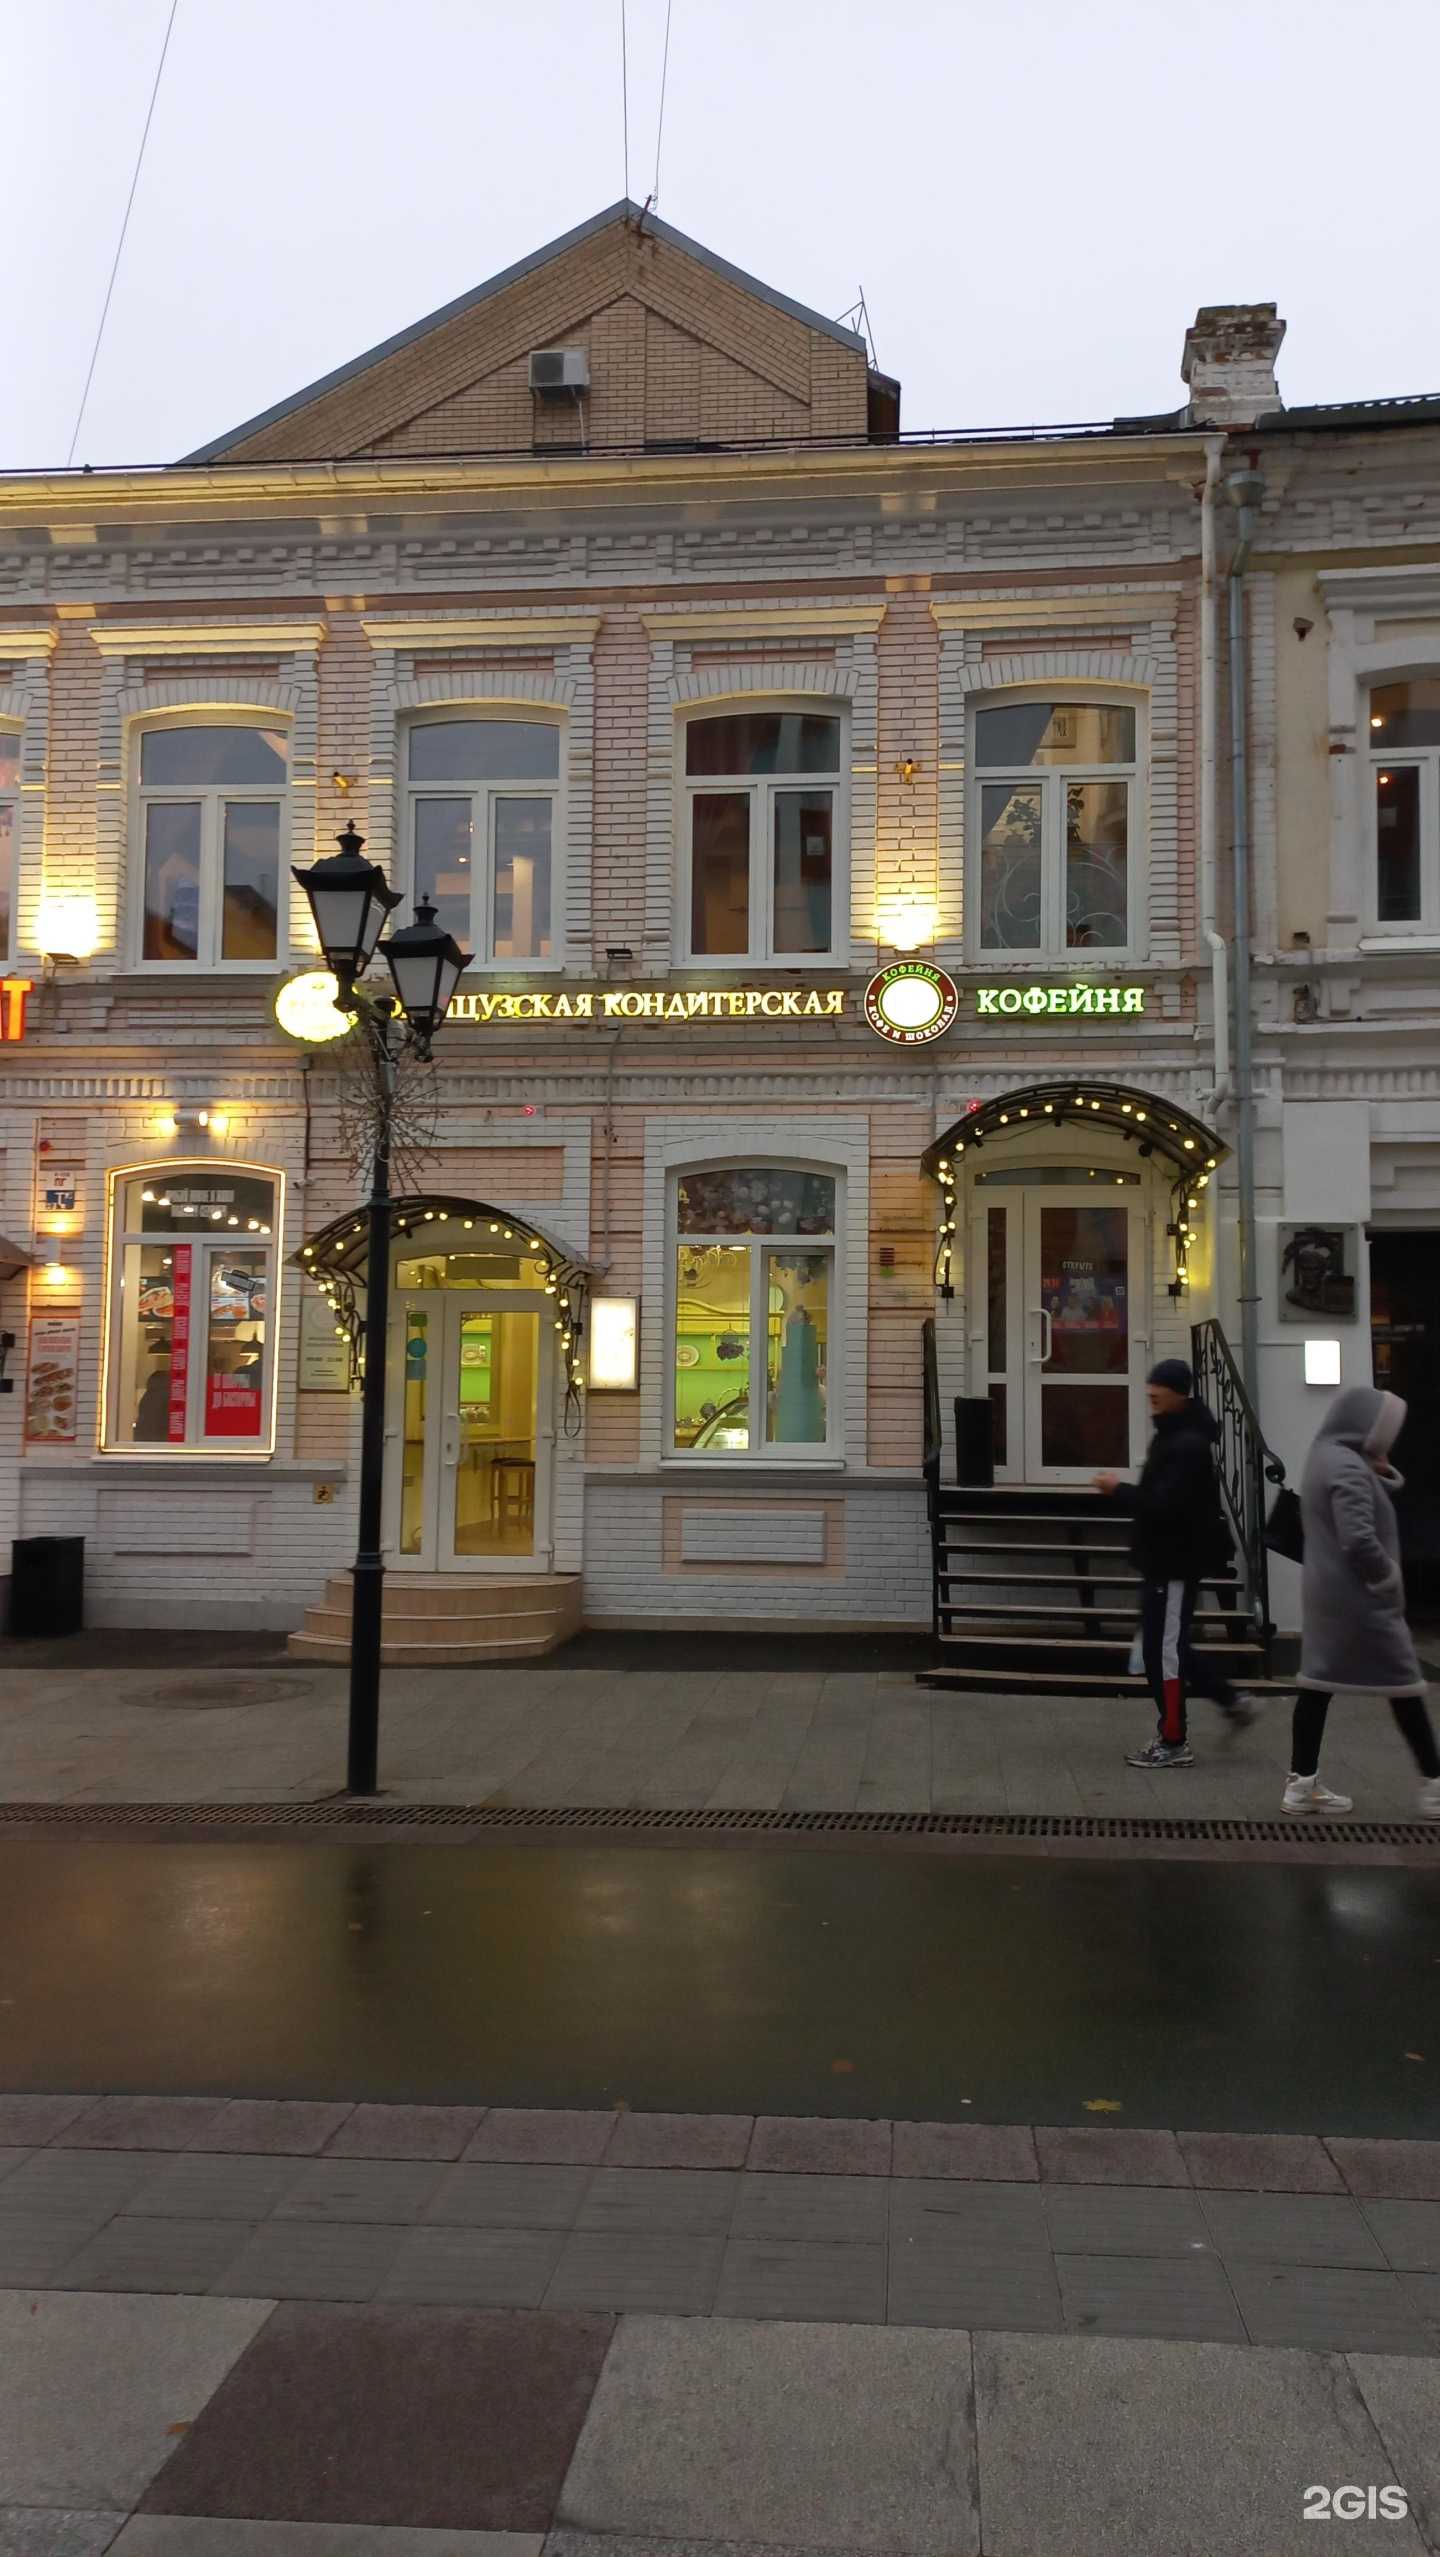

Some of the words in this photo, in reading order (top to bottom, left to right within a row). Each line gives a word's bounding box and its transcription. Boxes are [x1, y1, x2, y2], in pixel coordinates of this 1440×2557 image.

[882, 965, 941, 981] КОФЕЙНЯ
[391, 993, 593, 1021] ЦУЗСКАЯ
[602, 990, 844, 1020] КОНДИТЕРСКАЯ
[977, 983, 1145, 1014] КОФЕЙНЯ
[905, 1006, 955, 1041] ШОКОЛАД
